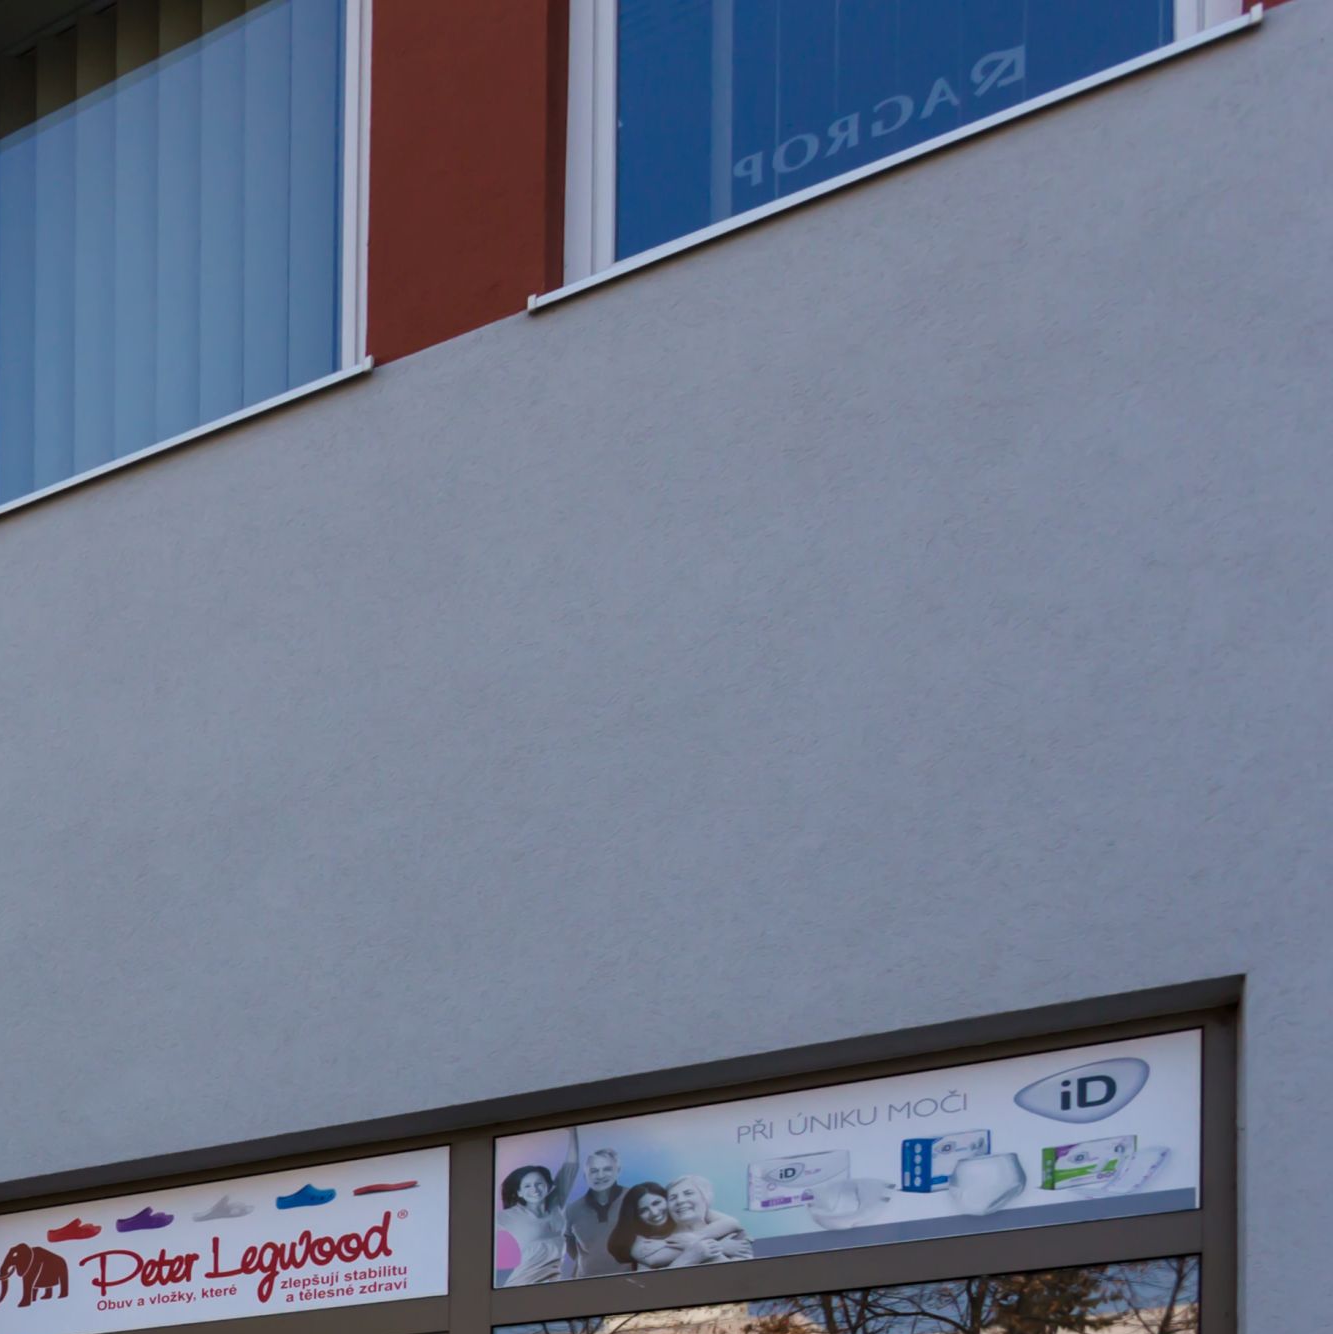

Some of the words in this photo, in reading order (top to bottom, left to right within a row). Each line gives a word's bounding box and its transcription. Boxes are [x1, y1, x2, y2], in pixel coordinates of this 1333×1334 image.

[1060, 1074, 1117, 1111] iD
[737, 1118, 773, 1144] PŘI
[788, 1106, 877, 1136] ÚNIKU
[888, 1090, 967, 1121] MOČI
[79, 1248, 200, 1297] Peter
[204, 1210, 393, 1303] Legwood
[280, 1271, 340, 1292] zlepšují
[343, 1265, 408, 1283] stabilitu
[286, 1294, 295, 1303] a
[298, 1283, 355, 1301] tělesné
[359, 1278, 408, 1295] zdraví
[97, 1298, 132, 1311] Obuv
[137, 1298, 145, 1307] a
[201, 1284, 238, 1298] které
